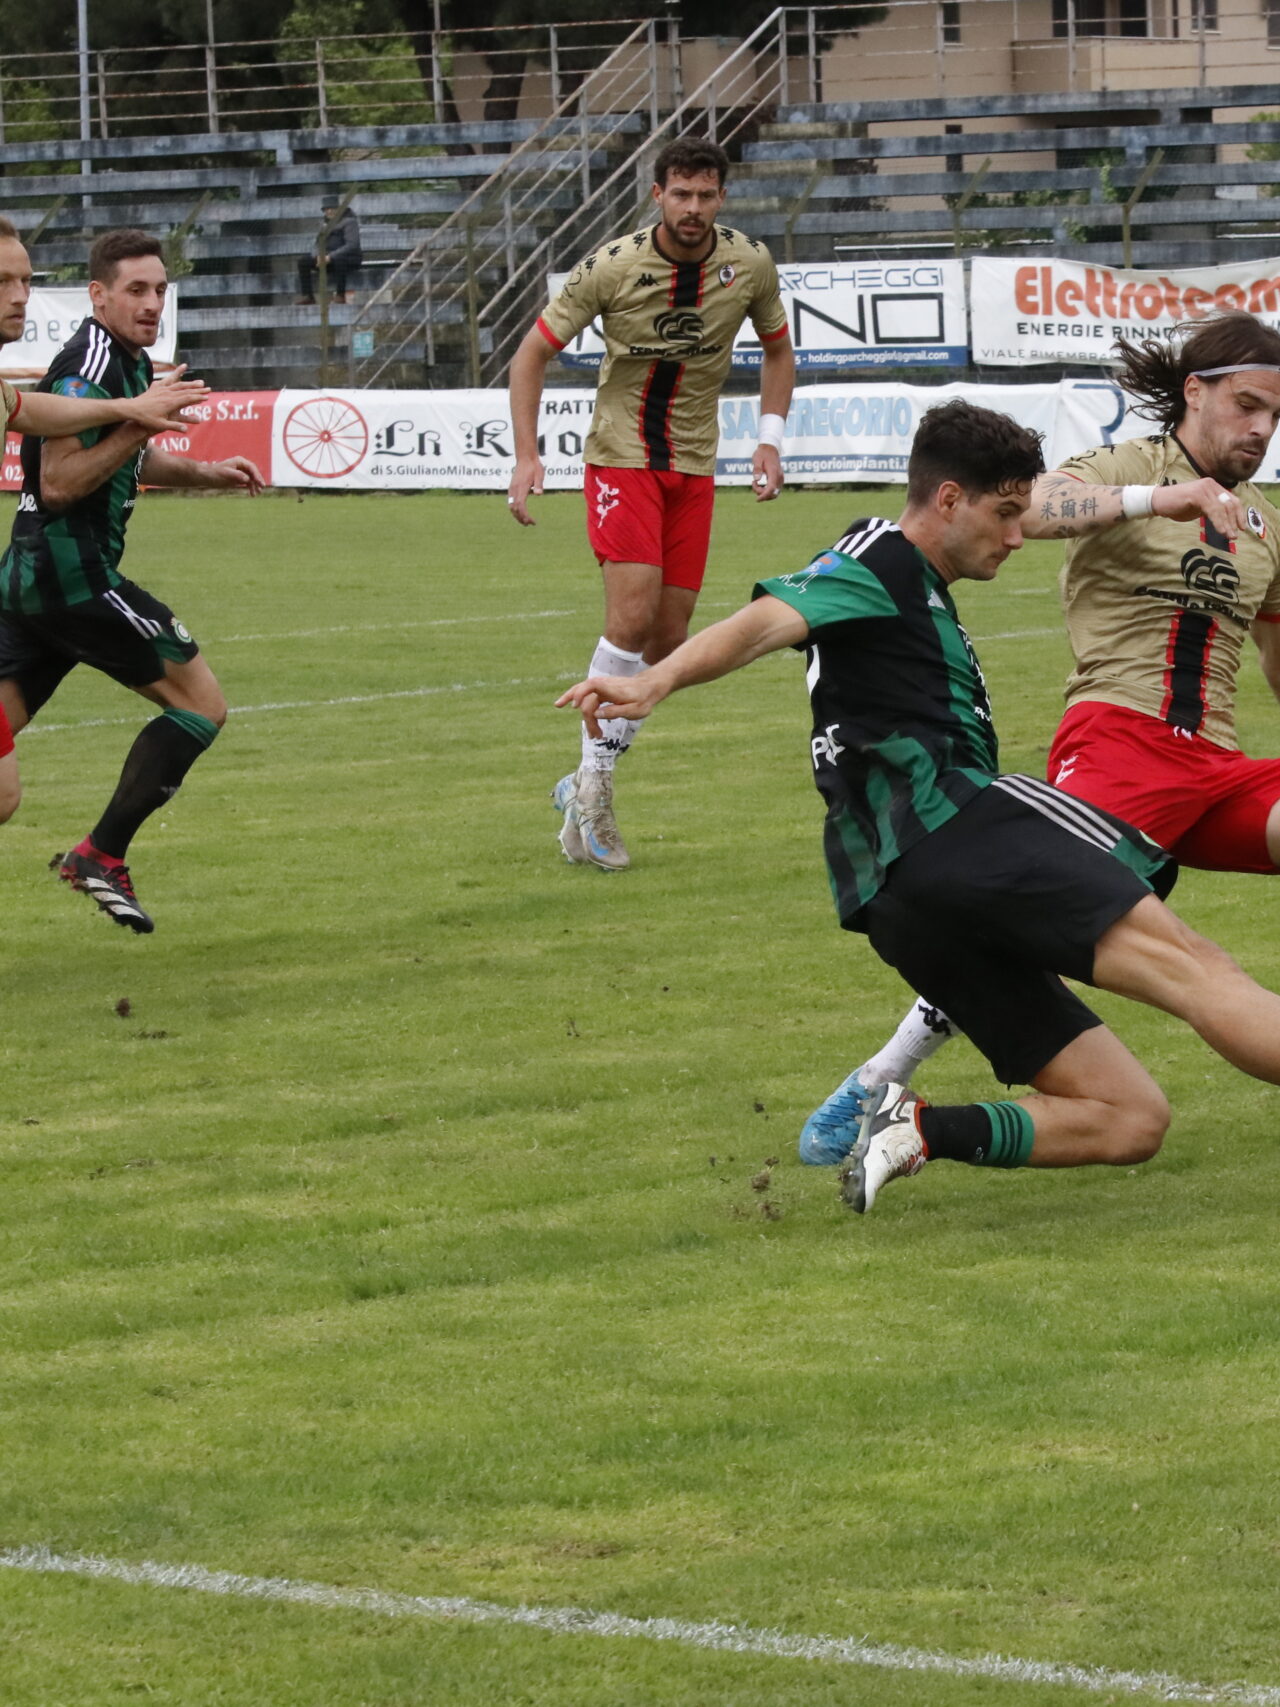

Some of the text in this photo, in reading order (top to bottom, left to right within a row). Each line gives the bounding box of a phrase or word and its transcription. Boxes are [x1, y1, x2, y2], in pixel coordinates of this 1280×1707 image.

[1017, 322, 1104, 338] ENERGIE
[981, 349, 1026, 358] VIALE
[371, 465, 383, 476] di
